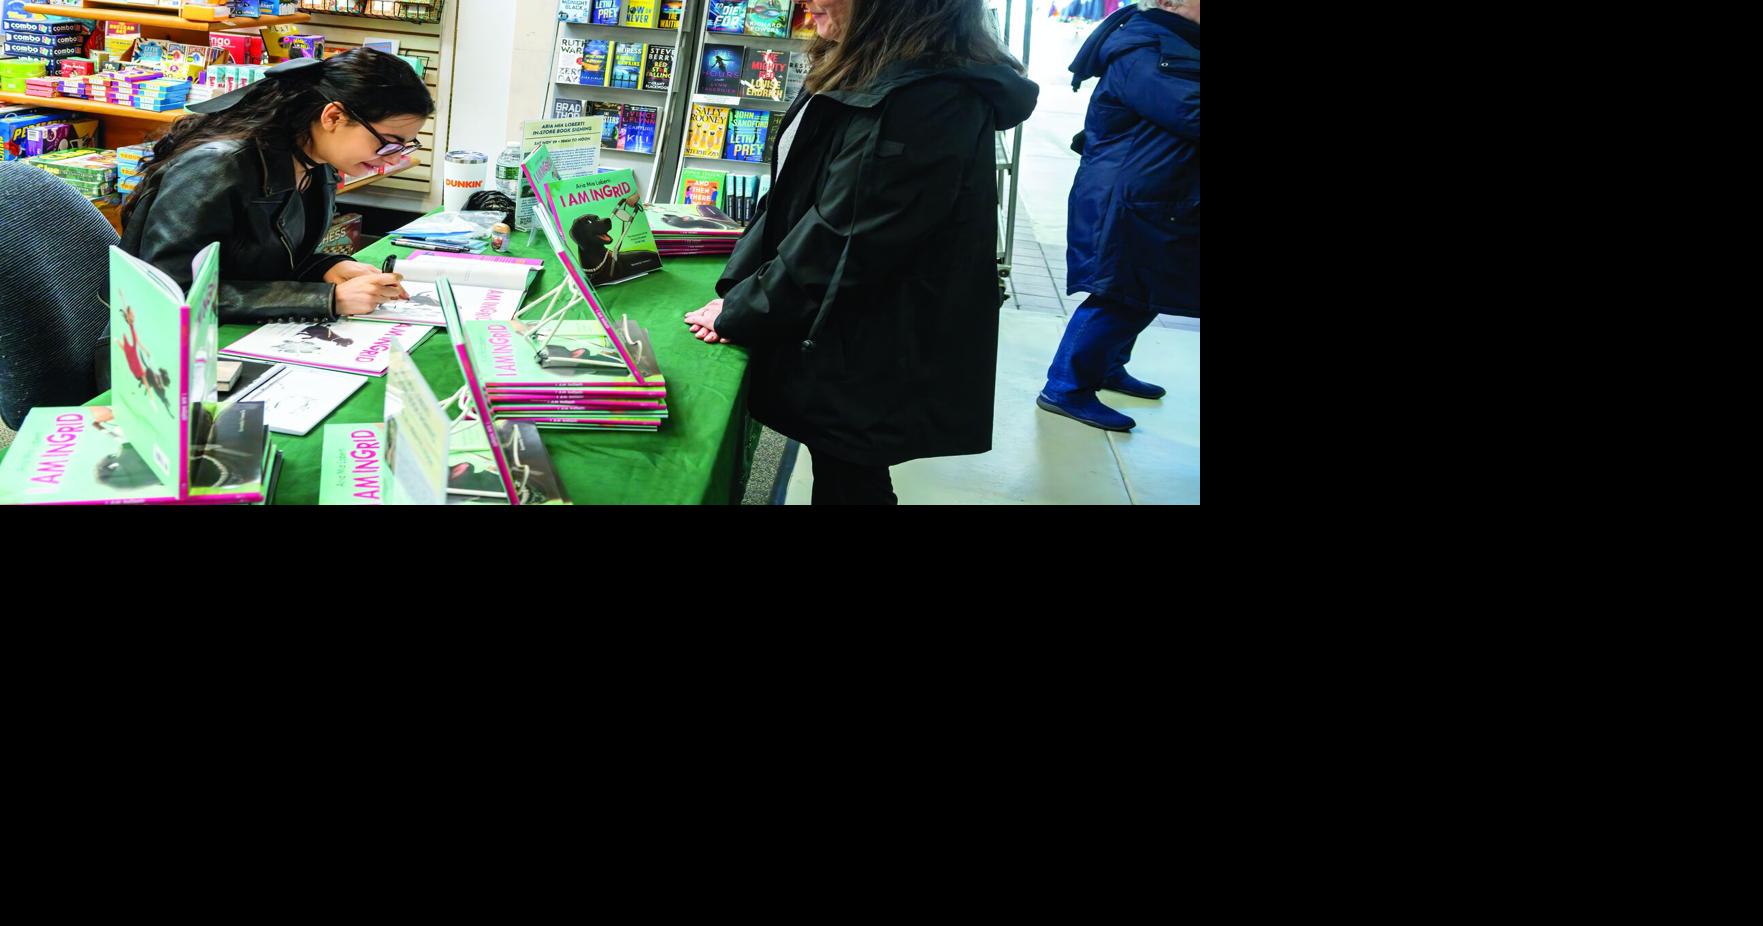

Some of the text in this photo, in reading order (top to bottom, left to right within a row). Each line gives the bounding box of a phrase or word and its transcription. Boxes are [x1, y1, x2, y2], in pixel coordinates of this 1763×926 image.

[598, 8, 617, 19] PREY
[722, 6, 740, 16] DIE
[626, 14, 648, 23] NEVER
[714, 16, 740, 28] FOR
[10, 22, 38, 31] combo
[14, 34, 40, 42] combo
[12, 45, 38, 53] combo
[561, 46, 584, 54] WAR
[752, 62, 785, 72] MIGHTY
[751, 79, 782, 89] LOUISE
[556, 102, 580, 112] BRAD
[696, 106, 724, 116] SALLY
[691, 114, 726, 124] ROONEY
[734, 110, 754, 119] JOHN
[732, 120, 768, 128] SANDFORD
[734, 144, 765, 156] PREY
[446, 178, 484, 188] DUNKIN'
[560, 181, 631, 208] I AM INGRID
[322, 228, 346, 244] HESS
[488, 324, 512, 354] INGRID
[493, 355, 517, 372] AM
[41, 413, 84, 457] INGRID
[350, 430, 380, 500] AM INGRID
[31, 459, 70, 484] AM
